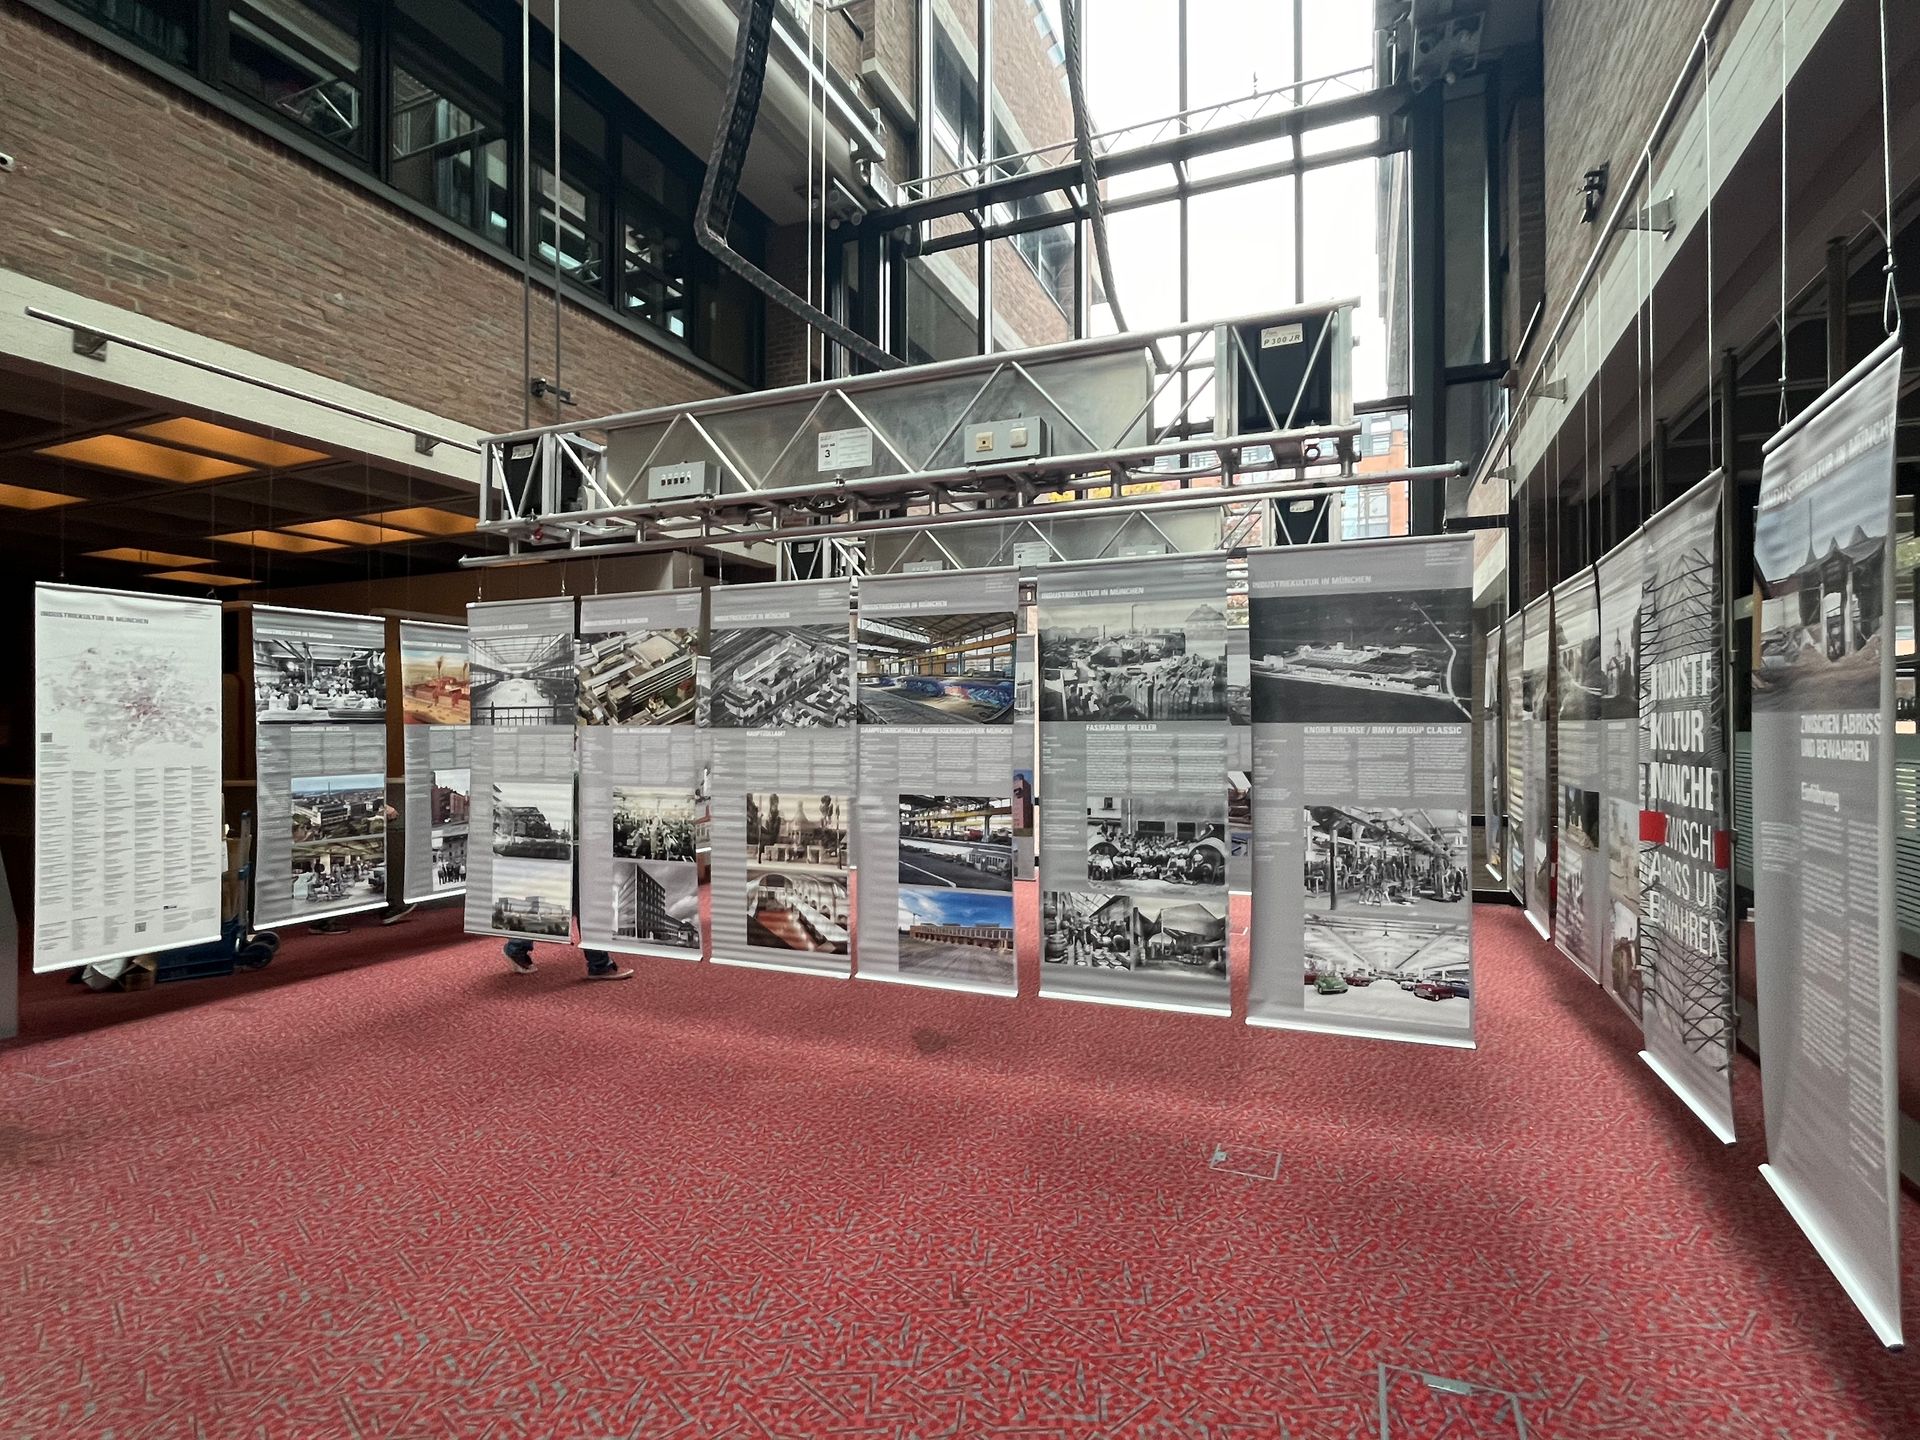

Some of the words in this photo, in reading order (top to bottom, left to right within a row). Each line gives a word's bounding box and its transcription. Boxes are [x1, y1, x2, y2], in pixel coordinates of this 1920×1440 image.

[1271, 336, 1288, 345] 300
[824, 449, 831, 458] 3
[1253, 579, 1320, 589] INDUSTRIEKULTUR
[1321, 577, 1330, 585] IN
[1331, 575, 1371, 585] MÜNCHEN
[1041, 590, 1100, 600] INDUSTRIEKULTUR
[1110, 587, 1144, 596] MÜNCHEN
[1086, 724, 1126, 732] FASSFABRIK
[1127, 723, 1158, 732] DREXLER
[1332, 726, 1365, 735] BREMSE
[1372, 726, 1395, 735] BMW
[1396, 726, 1425, 735] GROUP
[1426, 726, 1463, 735] CLASSIC
[1841, 713, 1882, 736] ABRISS
[1650, 710, 1704, 753] KULTUR
[1816, 739, 1869, 762] BEWAHREN
